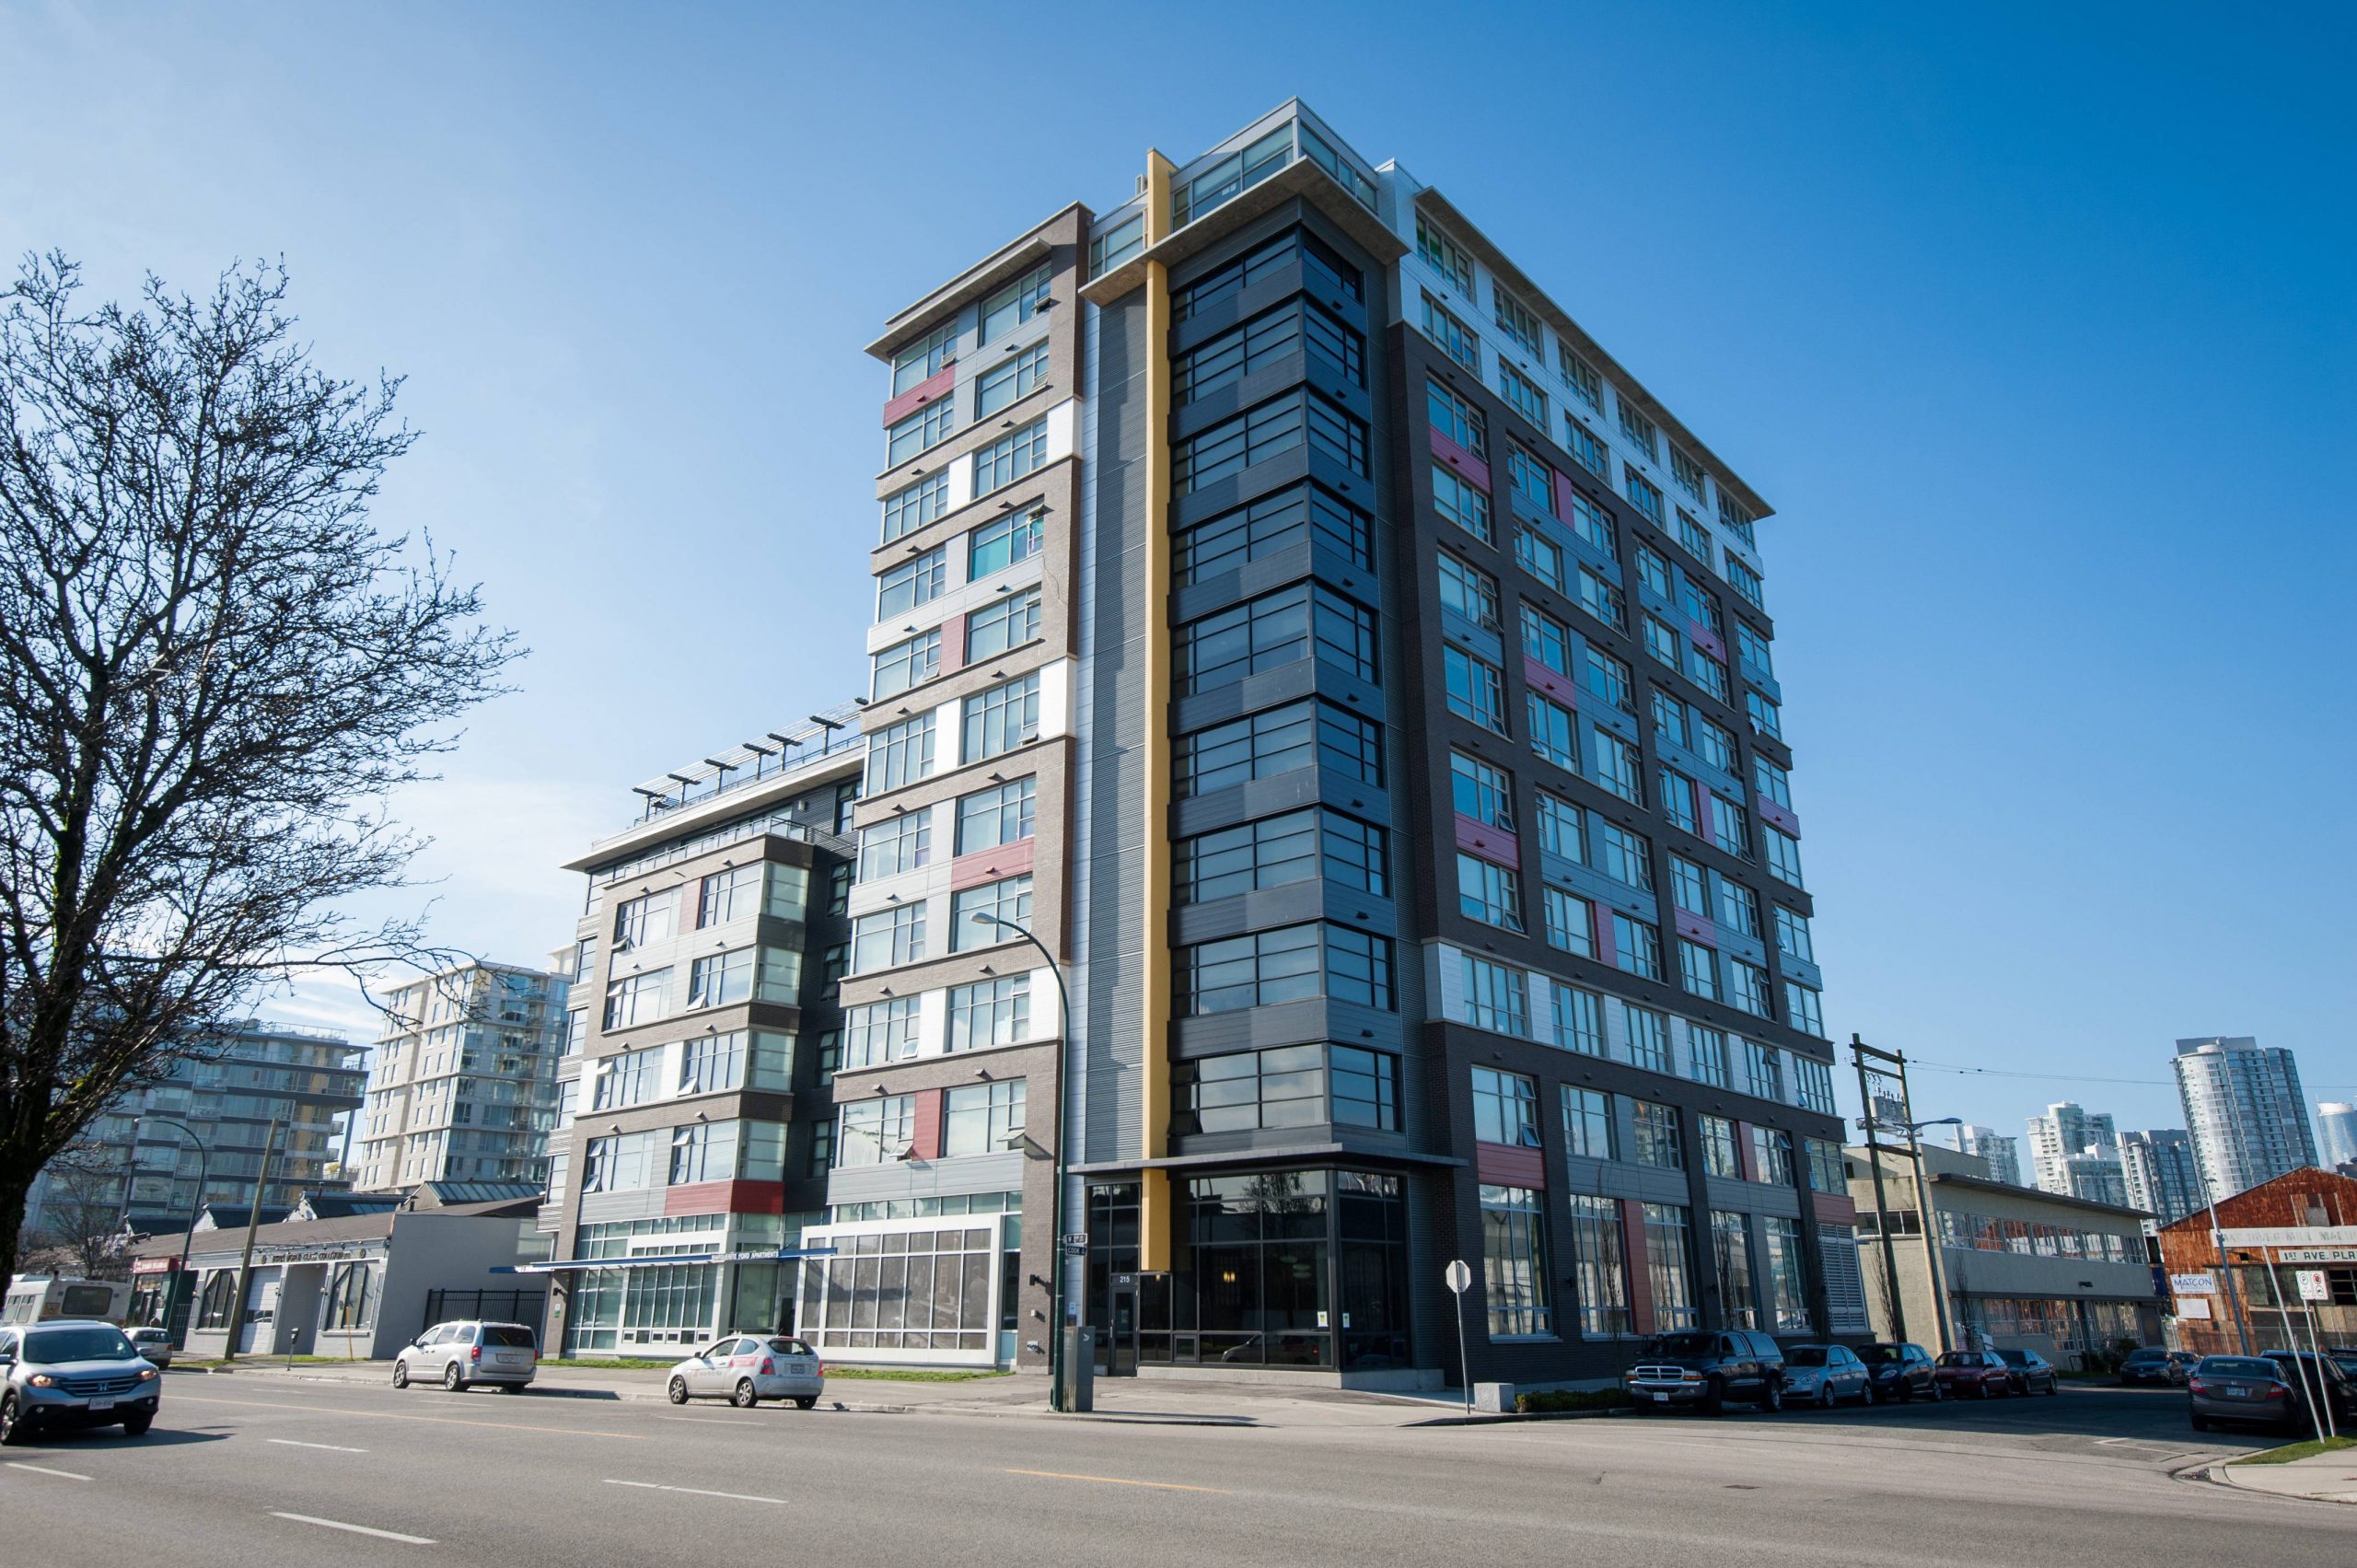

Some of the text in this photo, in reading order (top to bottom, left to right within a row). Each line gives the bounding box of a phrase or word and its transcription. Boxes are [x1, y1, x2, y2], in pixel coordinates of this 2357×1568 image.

[750, 1250, 779, 1260] APARTMENTS
[2304, 1251, 2329, 1260] AVE.
[2333, 1251, 2357, 1260] PLA
[1120, 1275, 1131, 1283] 215
[2174, 1277, 2212, 1289] MATCON
